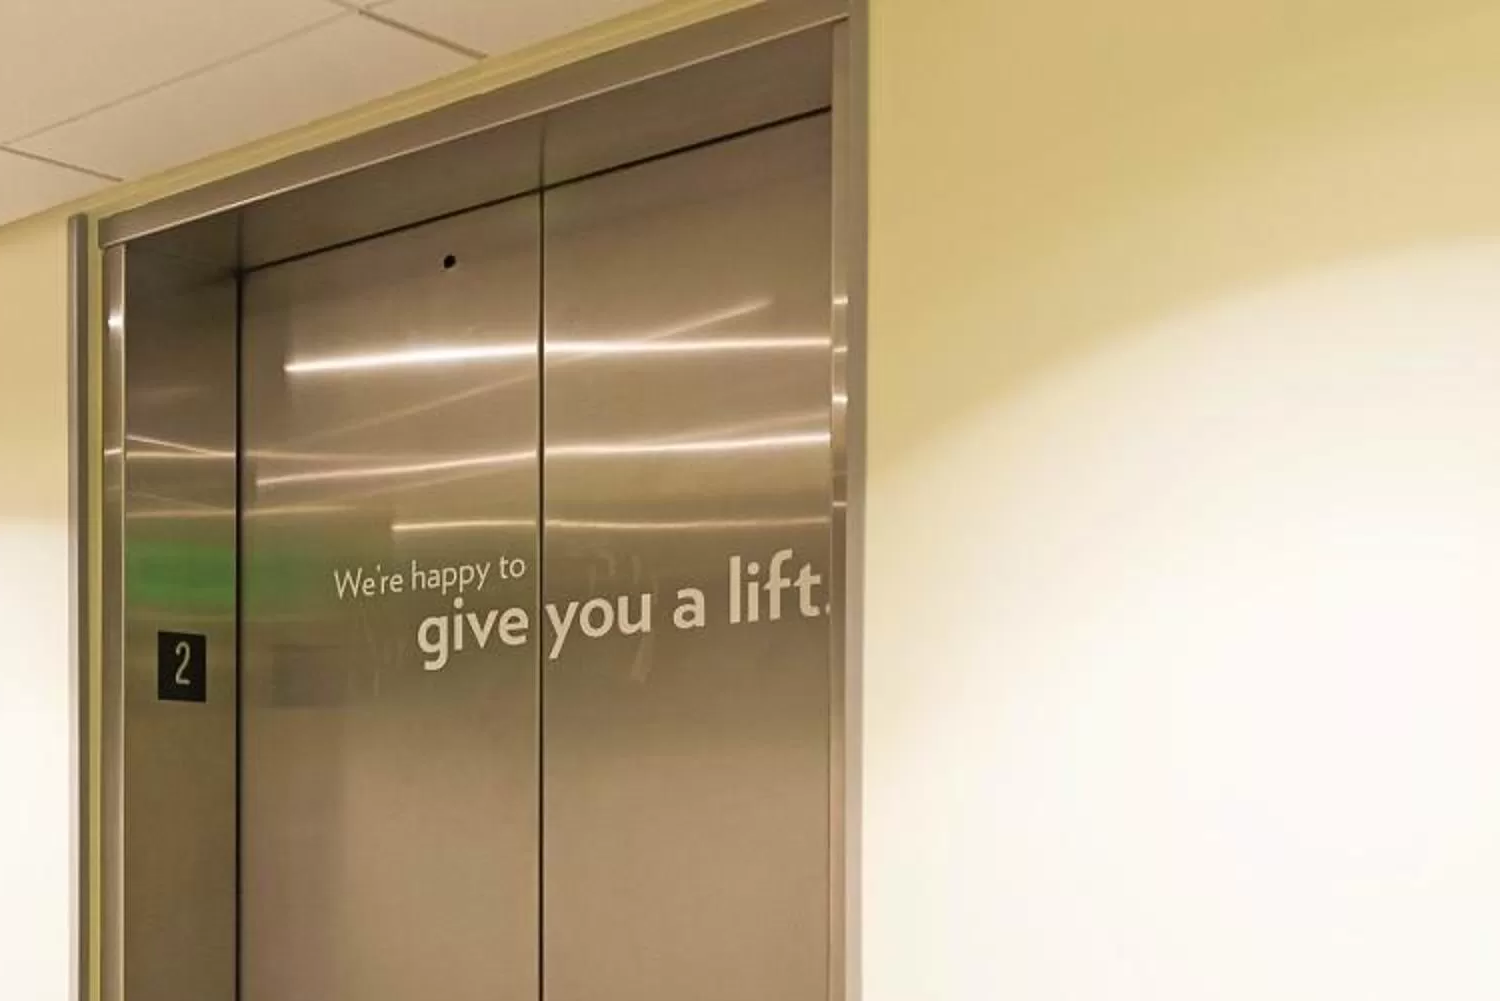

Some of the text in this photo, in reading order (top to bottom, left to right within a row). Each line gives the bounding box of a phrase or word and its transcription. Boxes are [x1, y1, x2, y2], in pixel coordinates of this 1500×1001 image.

[333, 556, 526, 600] We're happy to
[417, 597, 529, 671] give
[544, 593, 652, 659] you
[673, 587, 706, 629] a
[175, 640, 191, 685] 2
